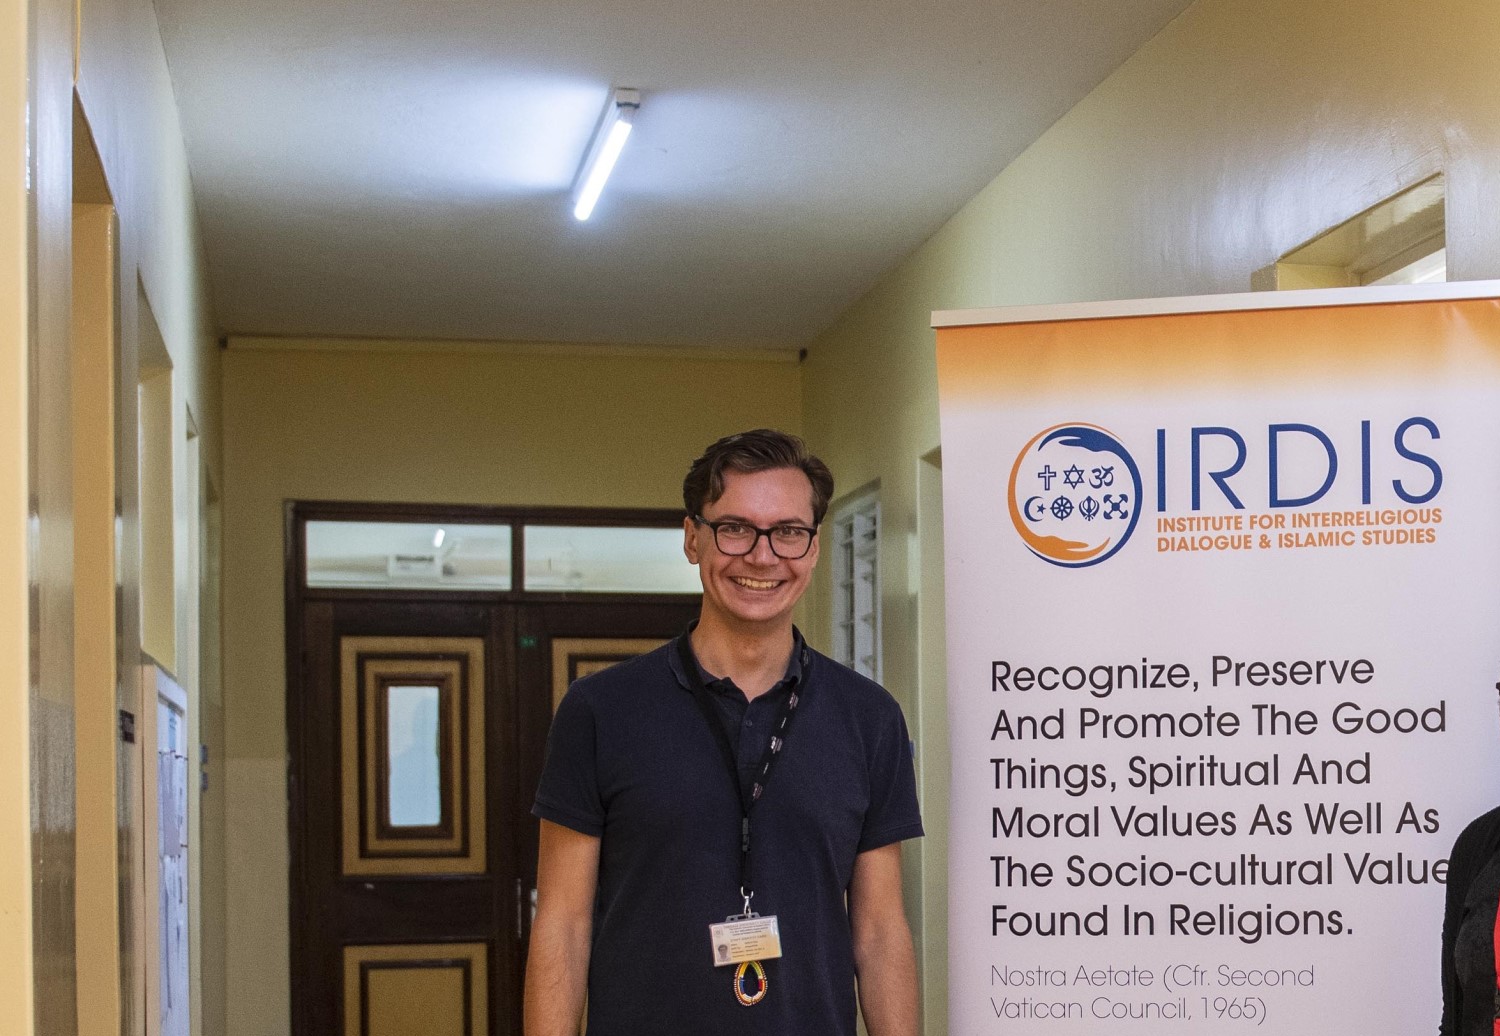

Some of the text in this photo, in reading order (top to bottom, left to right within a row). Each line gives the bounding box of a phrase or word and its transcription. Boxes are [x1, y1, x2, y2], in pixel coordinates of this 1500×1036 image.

[1157, 417, 1443, 512] IRDIS
[1157, 507, 1443, 533] INSTITUTE FOR INTERRELIGIOUS
[1157, 527, 1437, 552] DIALOGUE & ISLAMIC STUDIES
[991, 655, 1375, 698] Recognize, Preserve
[990, 700, 1446, 740] And Promote The Good
[990, 752, 1371, 797] Things, Spiritual And
[992, 801, 1440, 838] Moral Values As Well As
[990, 855, 1054, 888] The
[1066, 852, 1332, 887] Socio-cultural
[991, 902, 1354, 944] Found In Religions.
[991, 963, 1315, 992] Nostra Aetate (Cfr. Second
[990, 996, 1267, 1026] Vatican Council, 1965)
